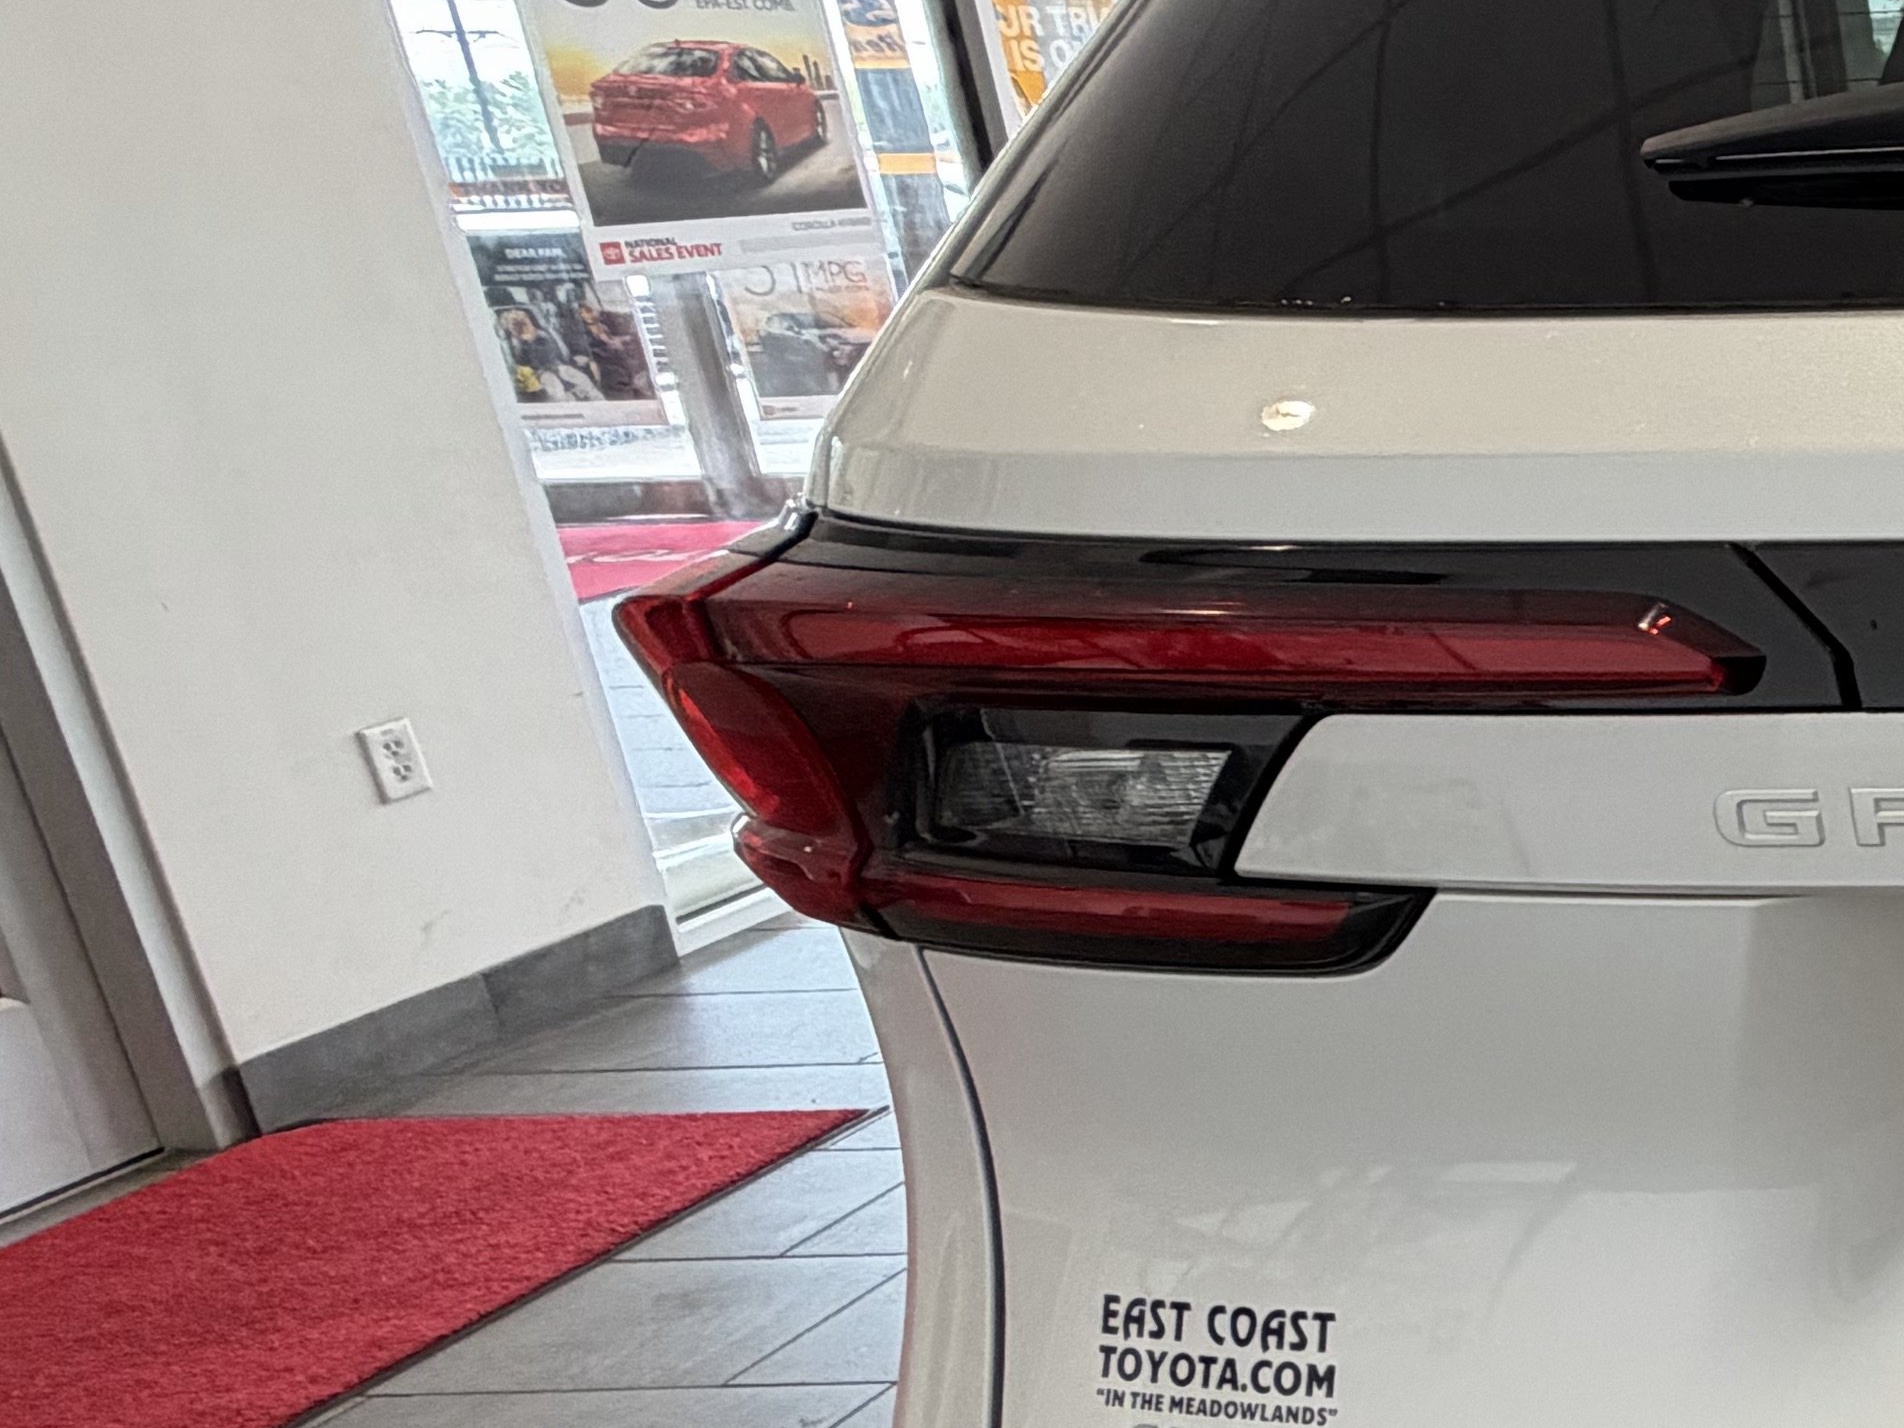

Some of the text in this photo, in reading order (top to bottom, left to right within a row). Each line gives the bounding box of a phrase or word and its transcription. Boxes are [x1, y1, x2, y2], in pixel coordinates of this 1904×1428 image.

[627, 247, 674, 264] SALES
[677, 242, 723, 259] EVENT
[1100, 1293, 1337, 1353] EAST COAST
[1098, 1344, 1337, 1399] TOYOTA.COM
[1130, 1391, 1165, 1413] THE
